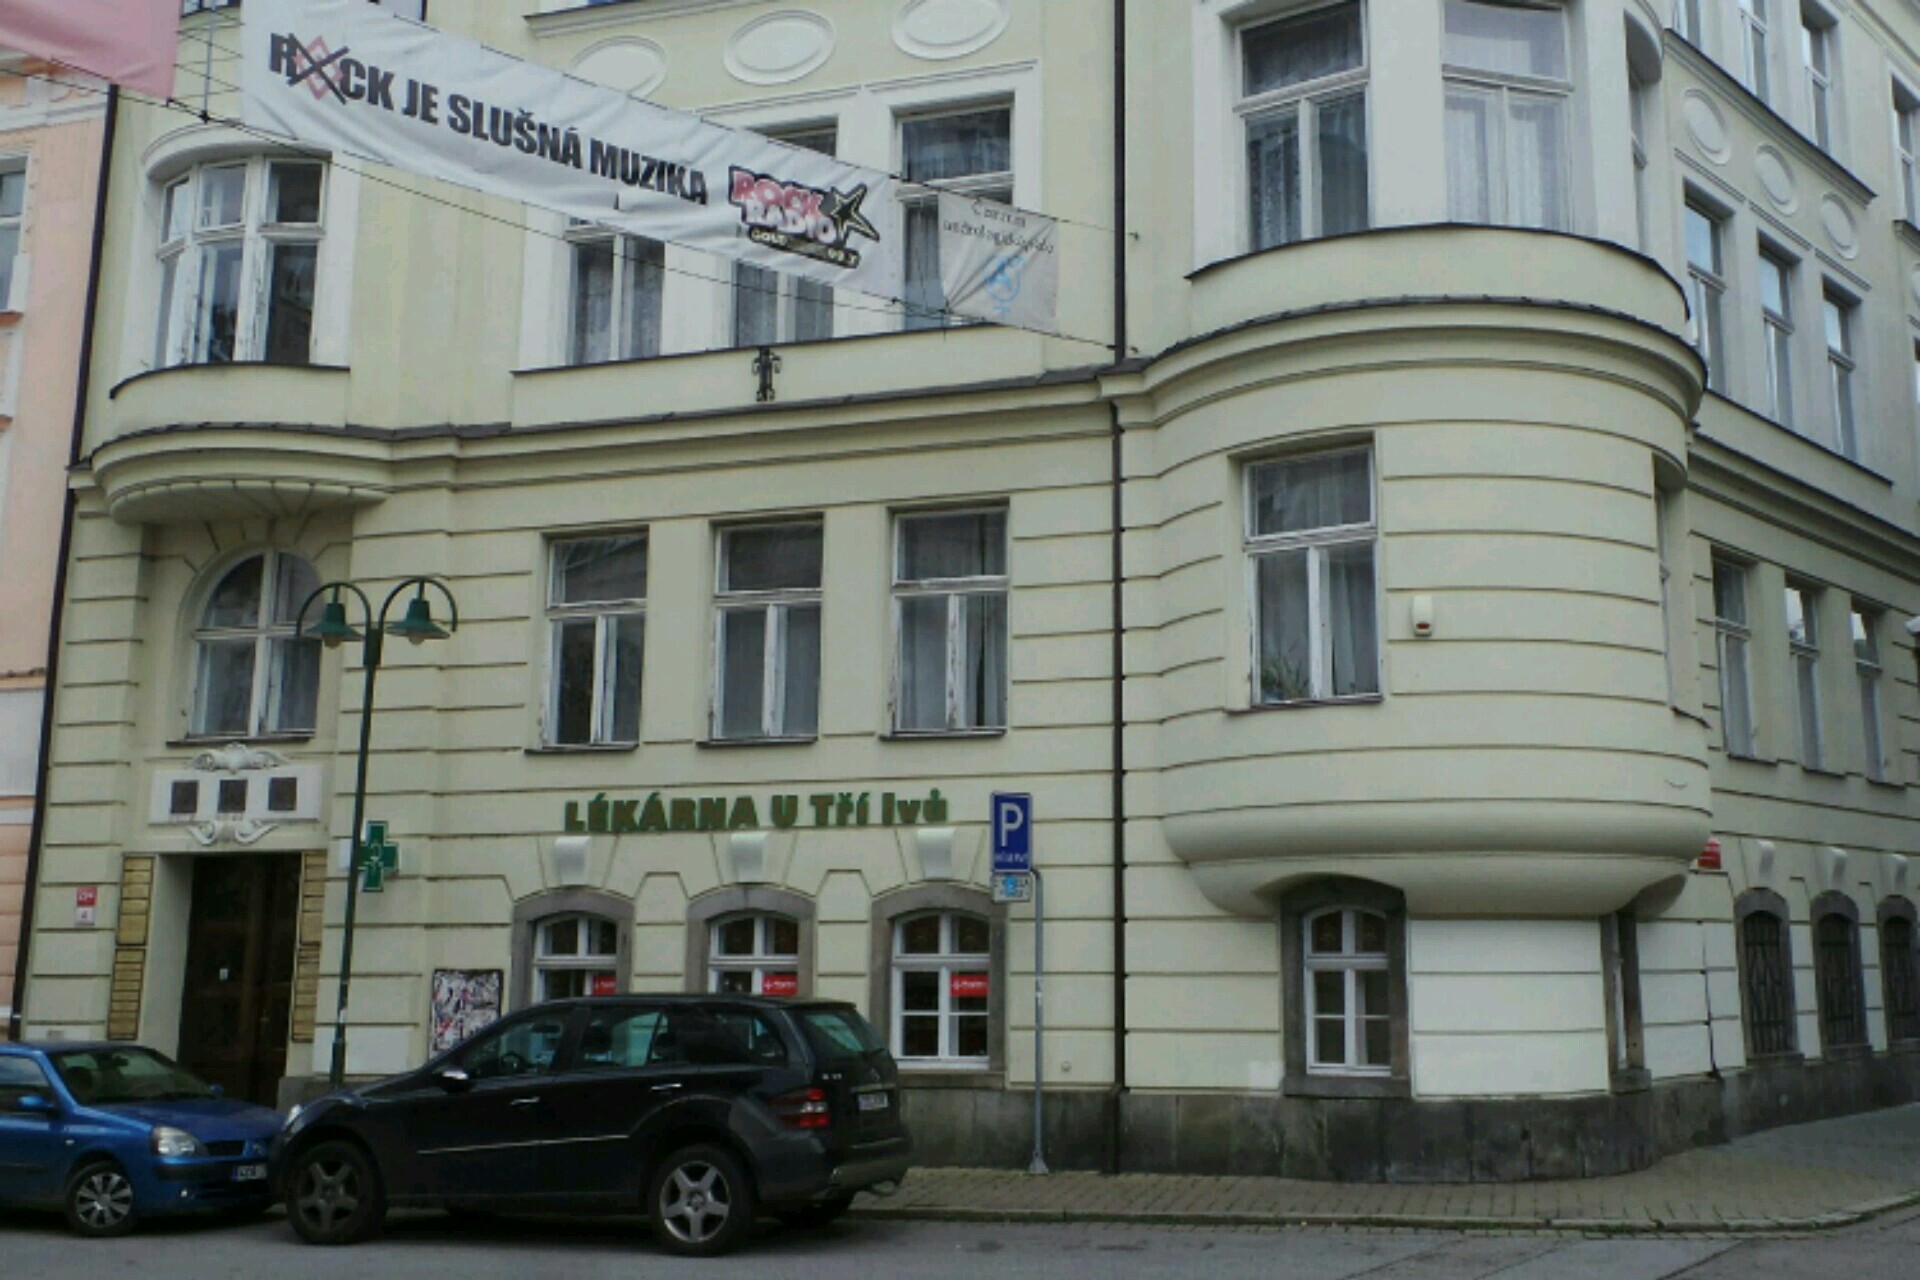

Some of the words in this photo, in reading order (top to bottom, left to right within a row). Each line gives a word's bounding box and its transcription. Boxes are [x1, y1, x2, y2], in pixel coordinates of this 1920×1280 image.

[403, 79, 438, 124] JE
[447, 93, 584, 170] SLUŠNÁ
[590, 137, 708, 205] MUZIKA
[731, 169, 824, 220] ROCK
[745, 199, 837, 244] RADIO
[564, 792, 760, 833] LÉKÁRNA
[771, 795, 798, 829] U
[809, 791, 870, 828] Tří
[1000, 801, 1024, 848] P
